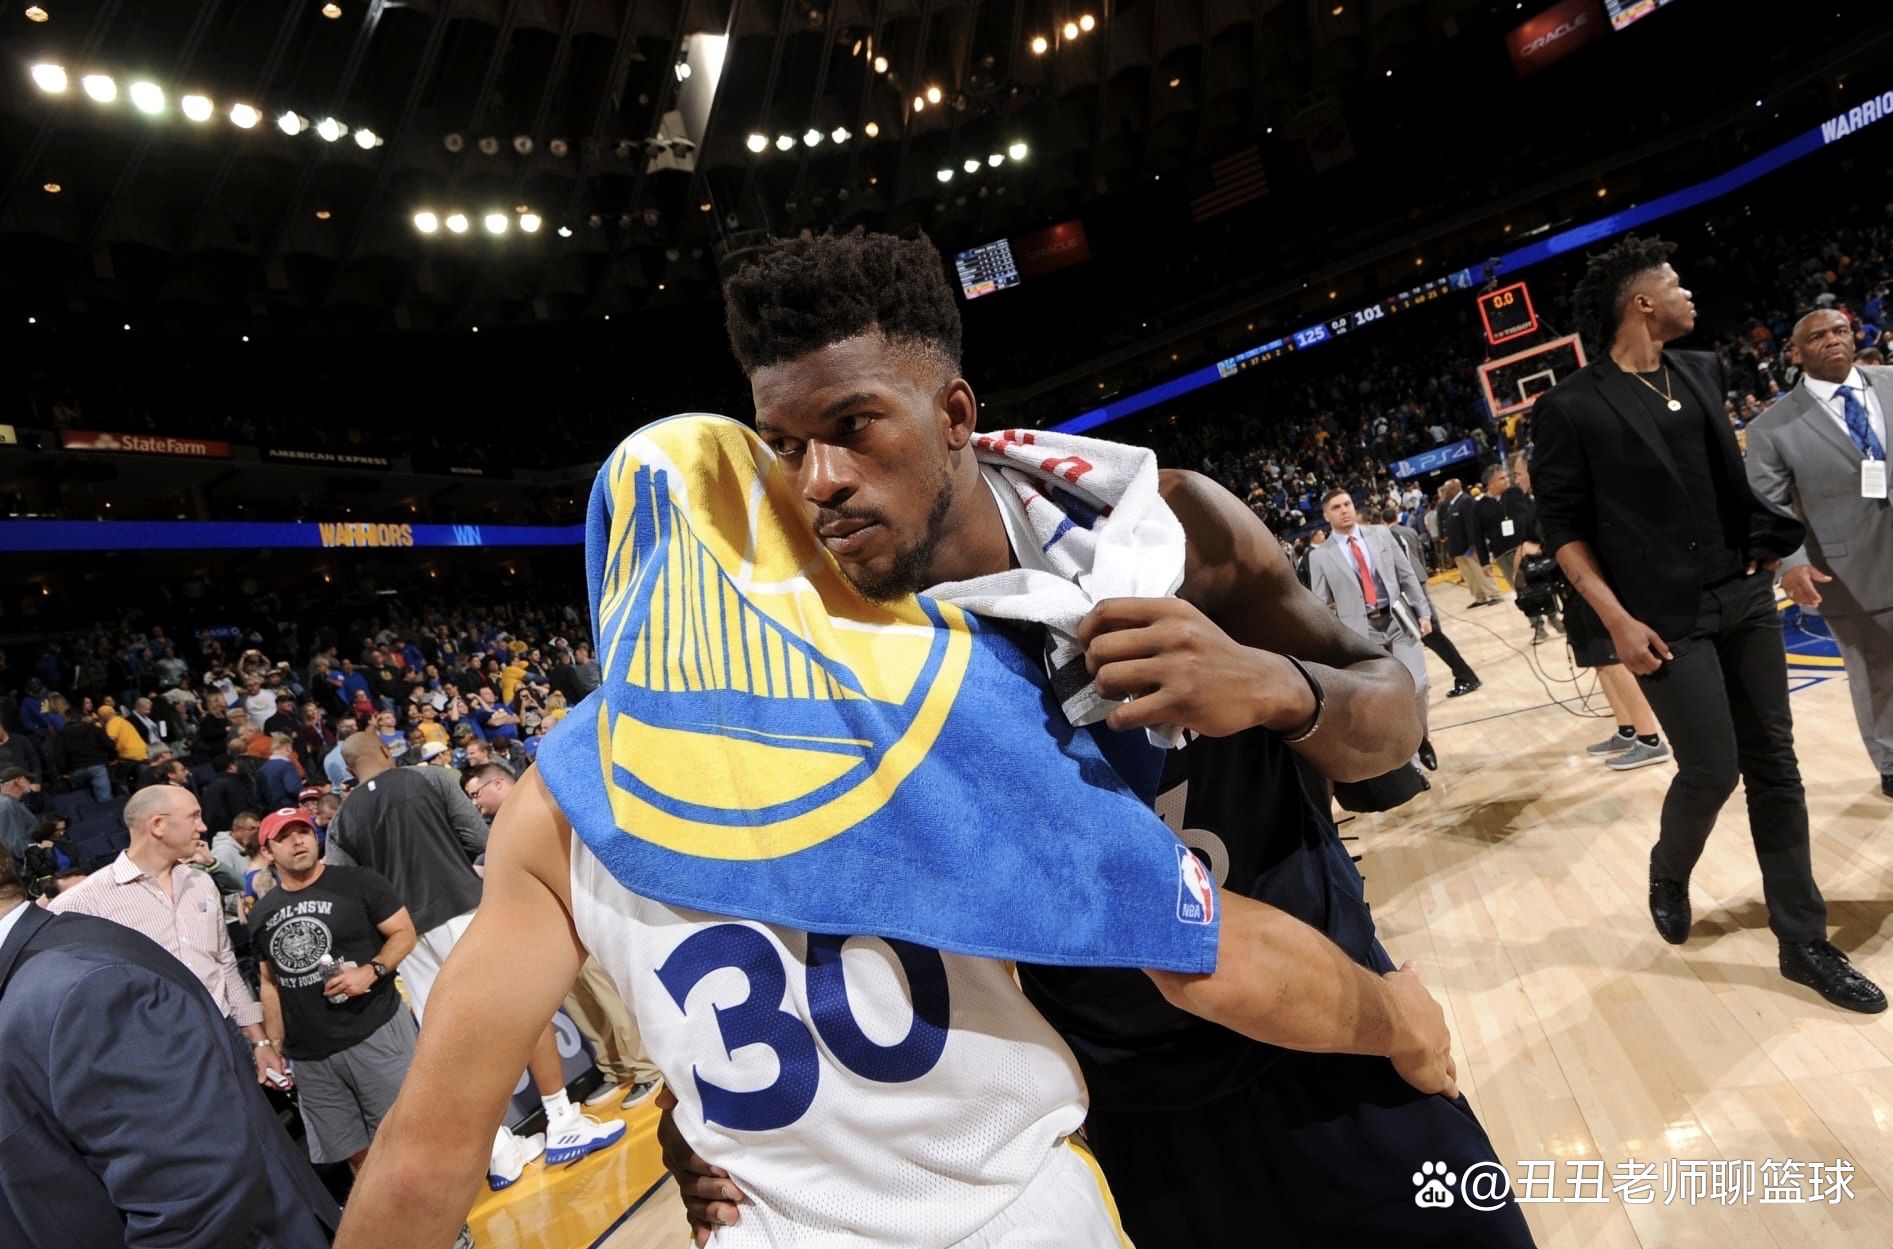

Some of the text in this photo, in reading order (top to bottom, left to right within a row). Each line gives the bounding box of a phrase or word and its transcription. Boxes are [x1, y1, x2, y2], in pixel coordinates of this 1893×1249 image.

[1519, 12, 1588, 58] ORACLE
[1821, 91, 1893, 144] WARRIO
[1493, 292, 1514, 308] 0.0
[1298, 326, 1325, 347] 125
[1331, 318, 1347, 330] 0.0
[1354, 304, 1384, 326] 101
[269, 448, 388, 466] AMERICAN EXPRESS
[1419, 444, 1471, 470] PS4
[319, 522, 414, 548] WARRIORS
[265, 900, 333, 932] SEAL-NSW
[1182, 902, 1201, 918] NBA
[653, 923, 950, 1132] 30
